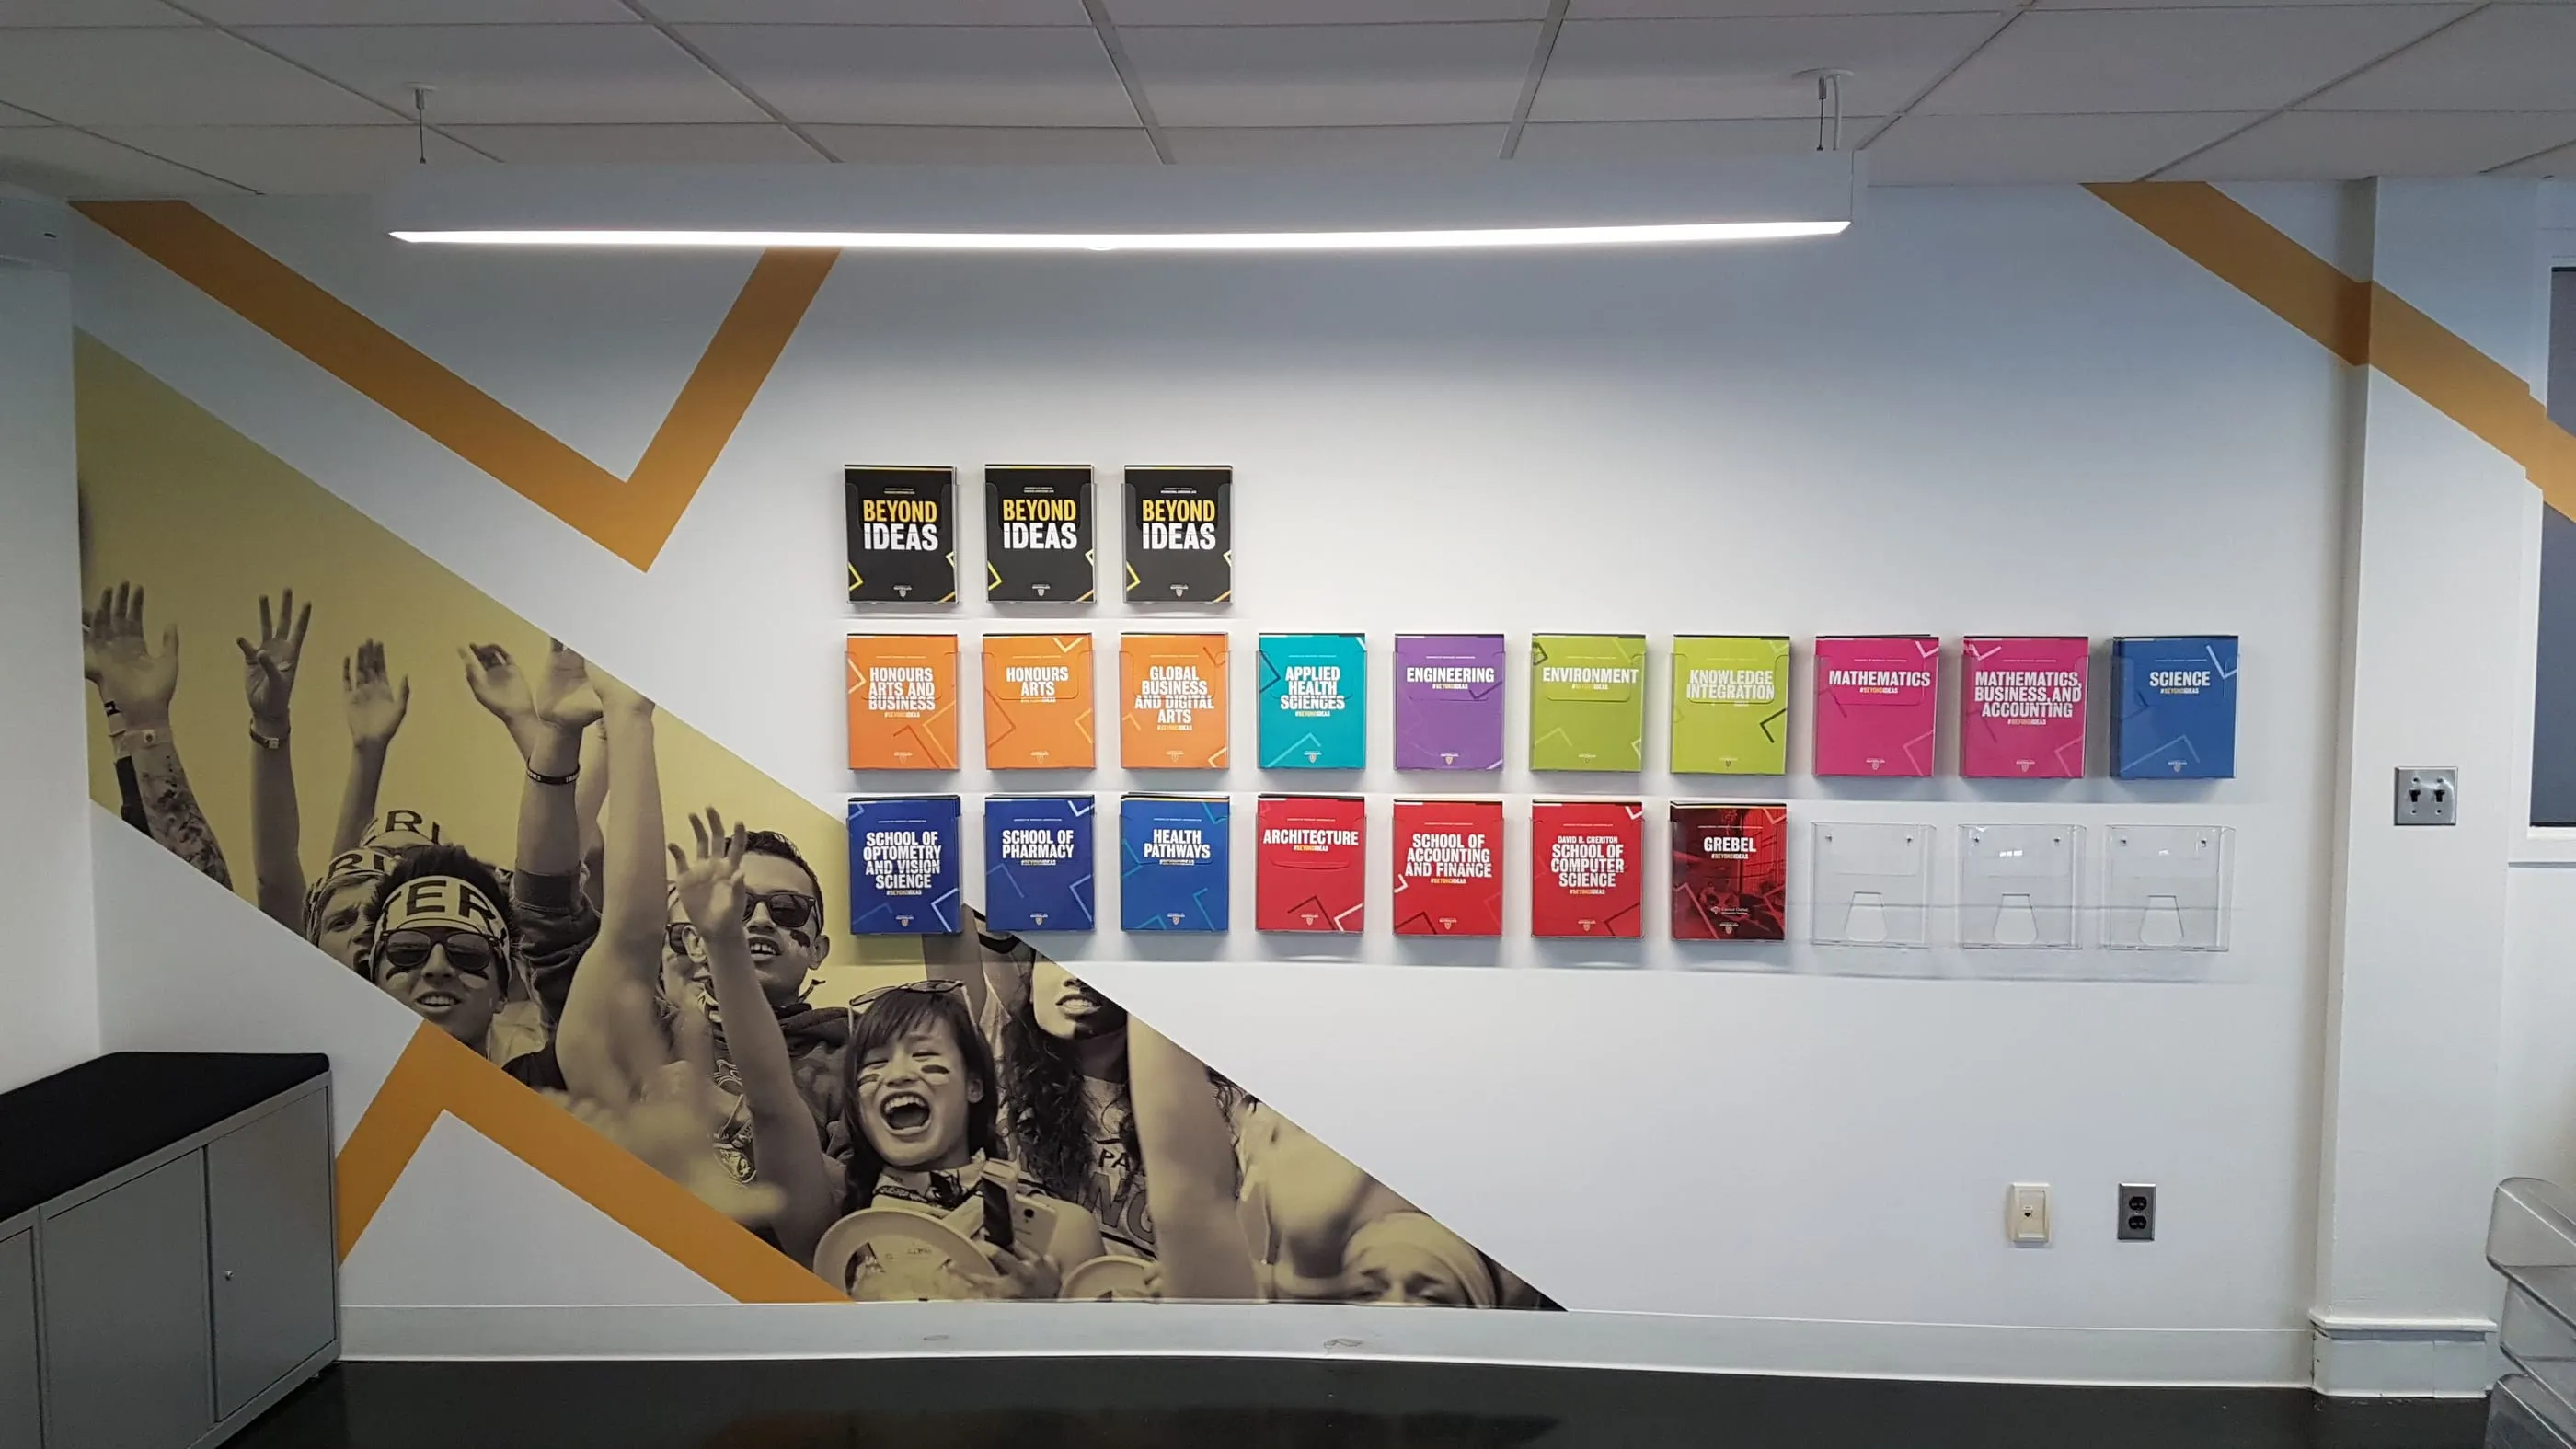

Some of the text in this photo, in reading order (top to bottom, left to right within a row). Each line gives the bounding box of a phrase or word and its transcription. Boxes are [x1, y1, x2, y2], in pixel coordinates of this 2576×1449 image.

[863, 500, 937, 523] BEYOND
[1003, 499, 1076, 521] BEYOND
[1143, 500, 1215, 521] BEYOND
[864, 523, 938, 551] IDEAS
[1003, 522, 1077, 549] IDEAS
[1143, 523, 1215, 549] IDEAS
[869, 667, 933, 682] HONOURS
[1006, 667, 1068, 682] HONOURS
[1150, 666, 1200, 681] GLOBAL
[1285, 666, 1340, 681] APPLIED
[1406, 667, 1495, 683] ENGINEERING
[1543, 667, 1639, 684] ENVIRONMENT
[1689, 669, 1774, 684] KNOWLEDGE
[1828, 670, 1931, 686] MATHEMATICS
[1975, 671, 2082, 689] MATHEMATICS,
[2149, 671, 2211, 686] SCIENCE
[869, 682, 935, 696] ARTS AND
[1021, 682, 1055, 696] ARTS
[1141, 680, 1208, 695] BUSINESS
[1289, 681, 1338, 696] HEALTH
[1686, 684, 1775, 699] INTEGRATION
[1974, 686, 2082, 704] BUSINESS, AND
[868, 696, 936, 710] BUSINESS
[1134, 695, 1214, 709] AND DIGITAL
[1280, 695, 1346, 710] SCIENCES
[1157, 709, 1192, 723] ARTS
[1982, 702, 2074, 718] ACCOUNTING
[866, 831, 938, 846] SCHOOL OF
[1002, 830, 1074, 845] SCHOOL OF
[1153, 829, 1202, 844] HEALTH
[1262, 829, 1359, 845] ARCHITECTURE
[1412, 834, 1485, 848] SCHOOL OF
[1002, 844, 1075, 858] PHARMACY
[1144, 843, 1211, 859] PATHWAYS
[1552, 844, 1624, 858] SCHOOL OF
[1703, 836, 1757, 853] GREBEL
[863, 845, 942, 861] OPTOMETRY
[1407, 847, 1490, 863] ACCOUNTING
[866, 859, 940, 875] AND VISION
[1405, 862, 1492, 878] AND FINANCE
[1550, 857, 1625, 873] COMPUTER
[875, 874, 932, 889] SCIENCE
[1558, 872, 1616, 888] SCIENCE
